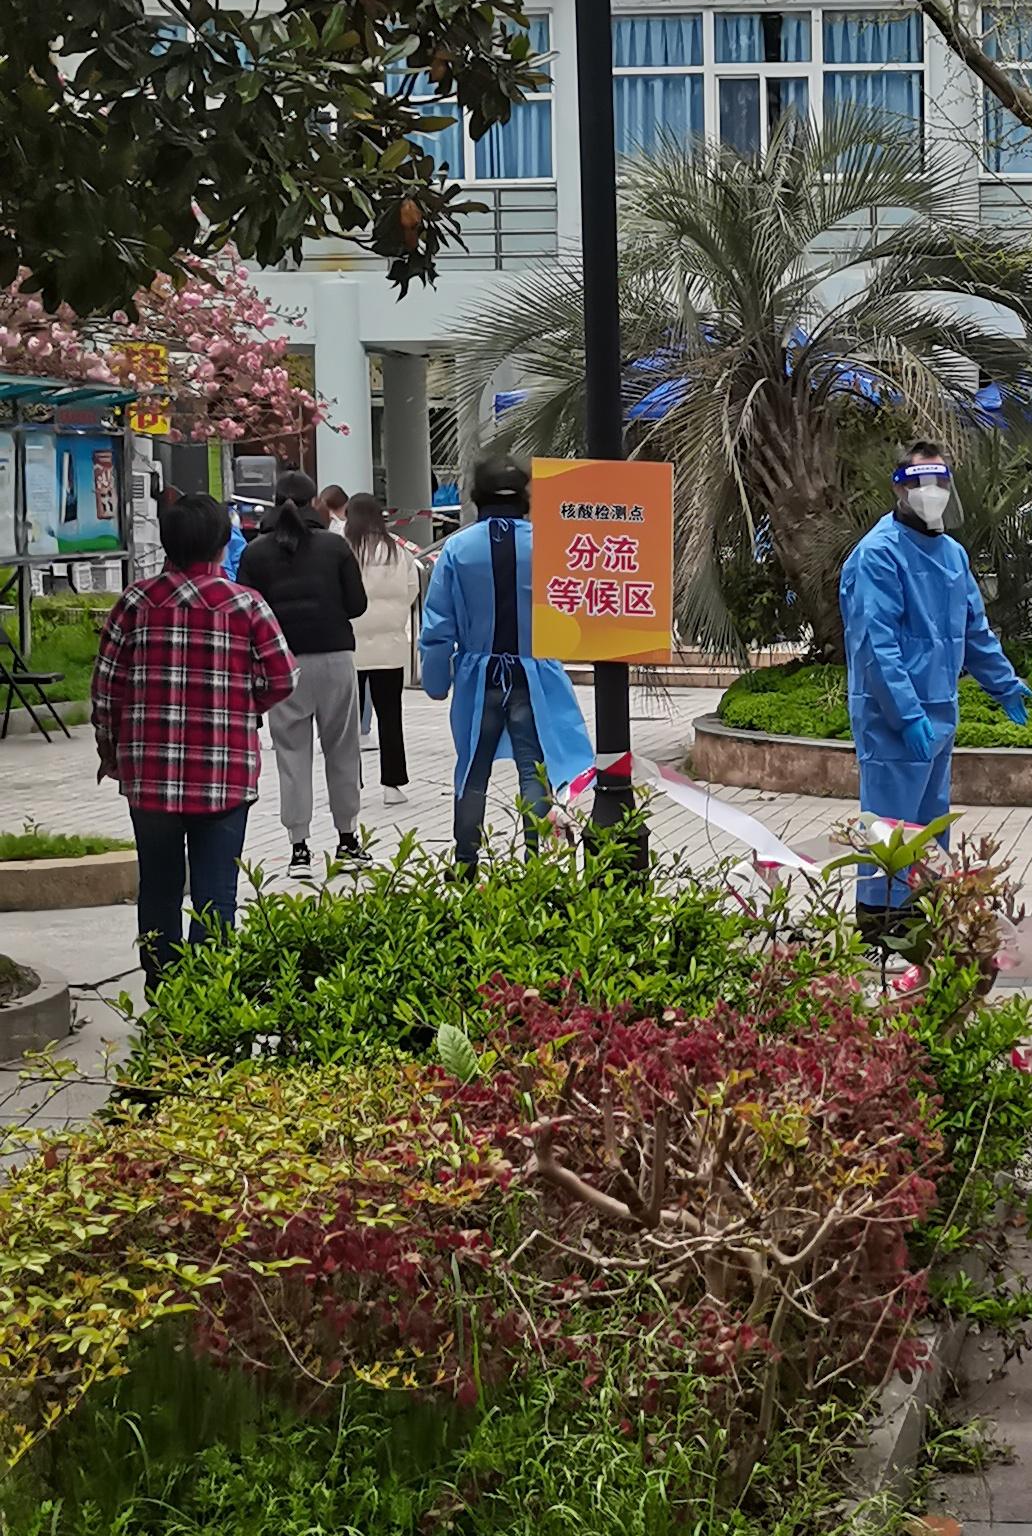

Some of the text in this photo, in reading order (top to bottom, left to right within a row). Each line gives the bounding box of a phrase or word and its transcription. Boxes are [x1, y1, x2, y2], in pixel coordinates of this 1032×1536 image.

[560, 502, 645, 521] 核酸检测点
[567, 534, 640, 571] 分流
[548, 577, 656, 617] 等候区
